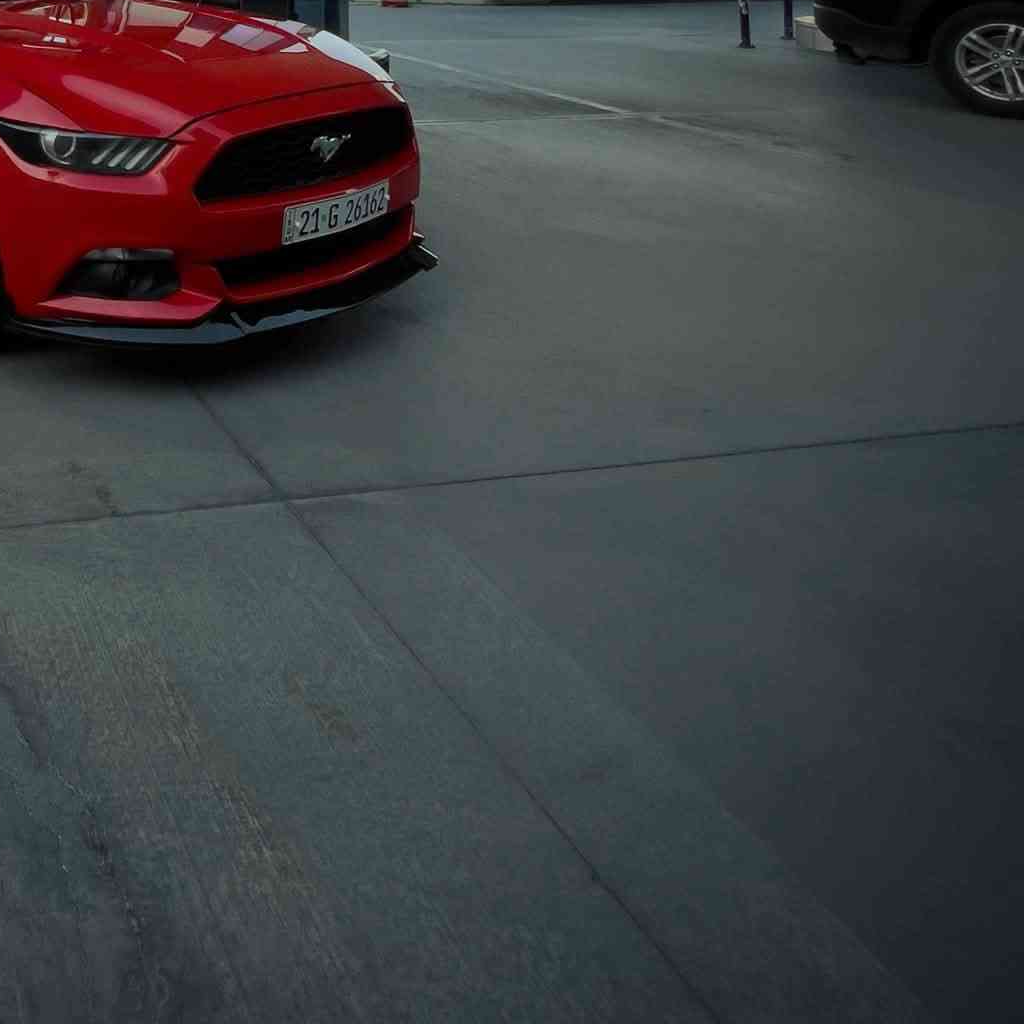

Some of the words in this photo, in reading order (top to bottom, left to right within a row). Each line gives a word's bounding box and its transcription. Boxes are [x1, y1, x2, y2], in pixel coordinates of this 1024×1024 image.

[299, 208, 320, 236] 21
[328, 204, 339, 229] G
[345, 187, 384, 224] 26162
